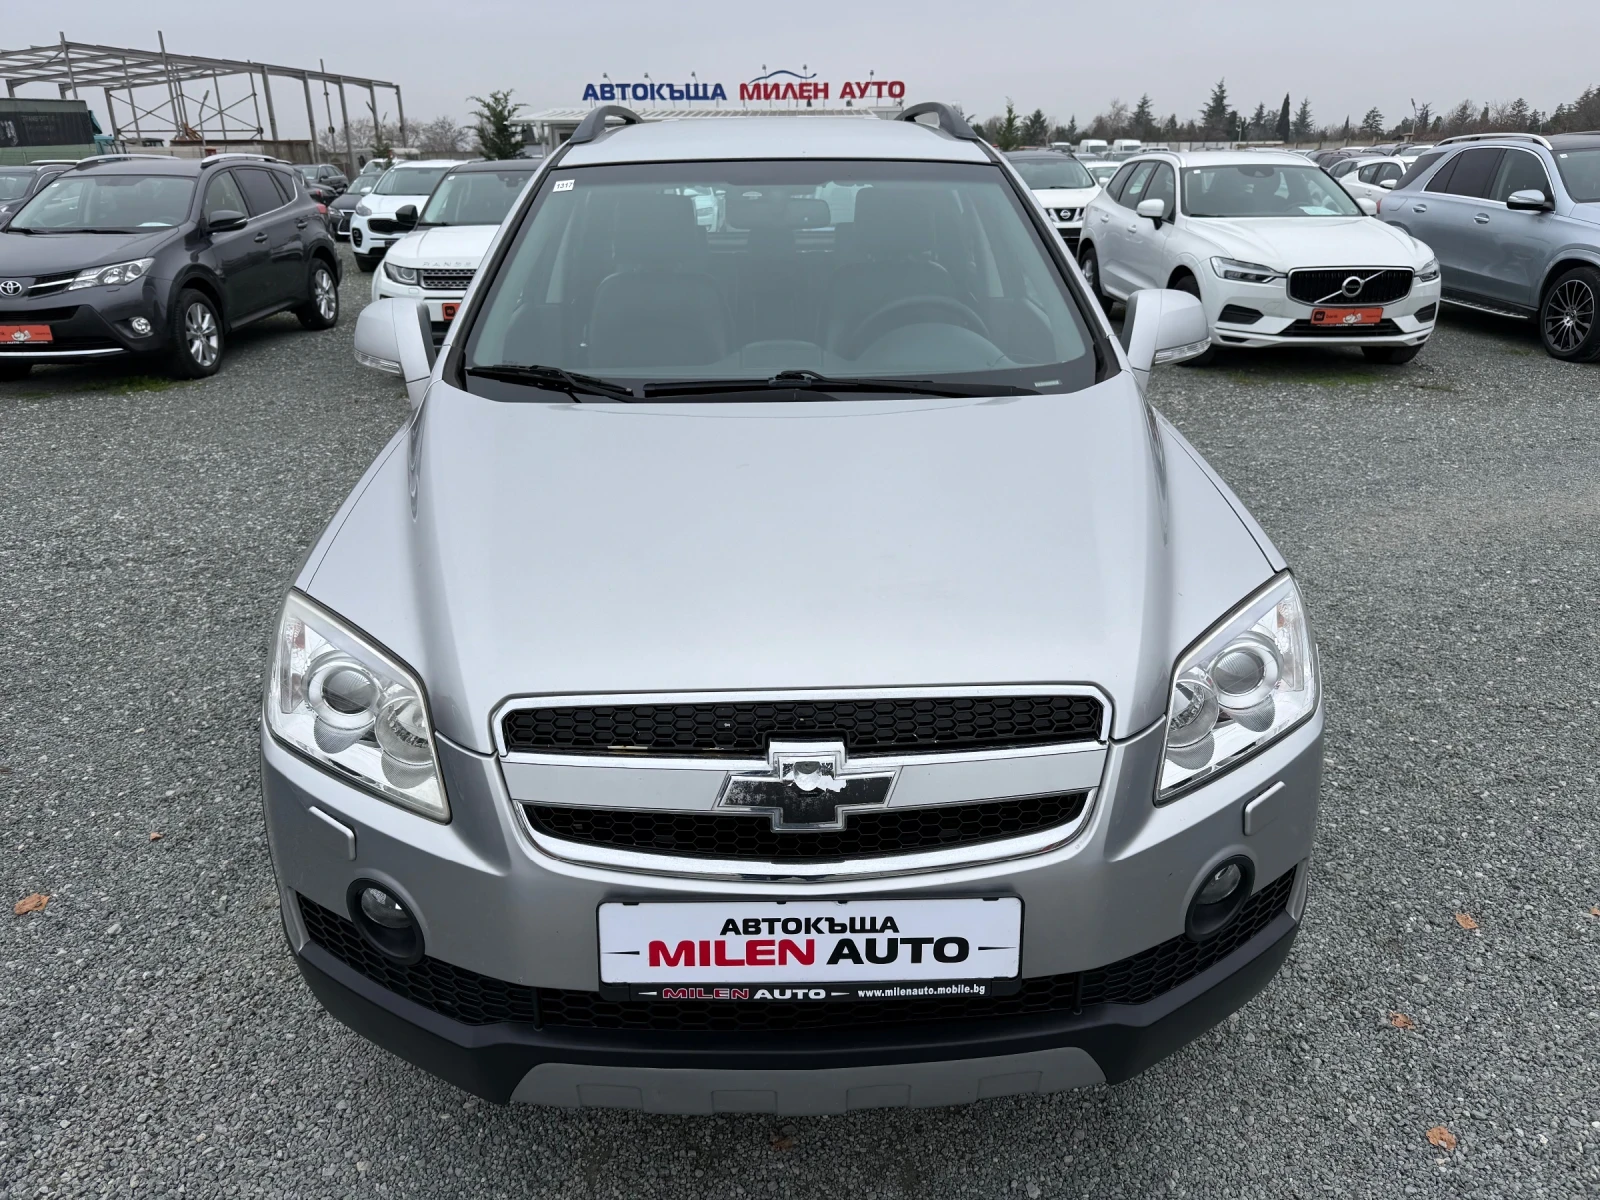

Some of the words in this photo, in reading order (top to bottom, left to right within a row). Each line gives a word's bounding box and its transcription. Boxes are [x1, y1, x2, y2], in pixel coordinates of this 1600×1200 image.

[582, 83, 727, 101] АВТОКЪЩА
[739, 81, 829, 101] МИЛЕН
[839, 80, 905, 99] АУТО
[720, 916, 900, 936] АВТОКЪЩА
[648, 939, 815, 967] MILEN
[826, 937, 970, 965] AUTO
[662, 988, 749, 1000] MILEN
[753, 988, 826, 1000] AUTO
[857, 984, 986, 998] www.milenauto.mobile.bg
